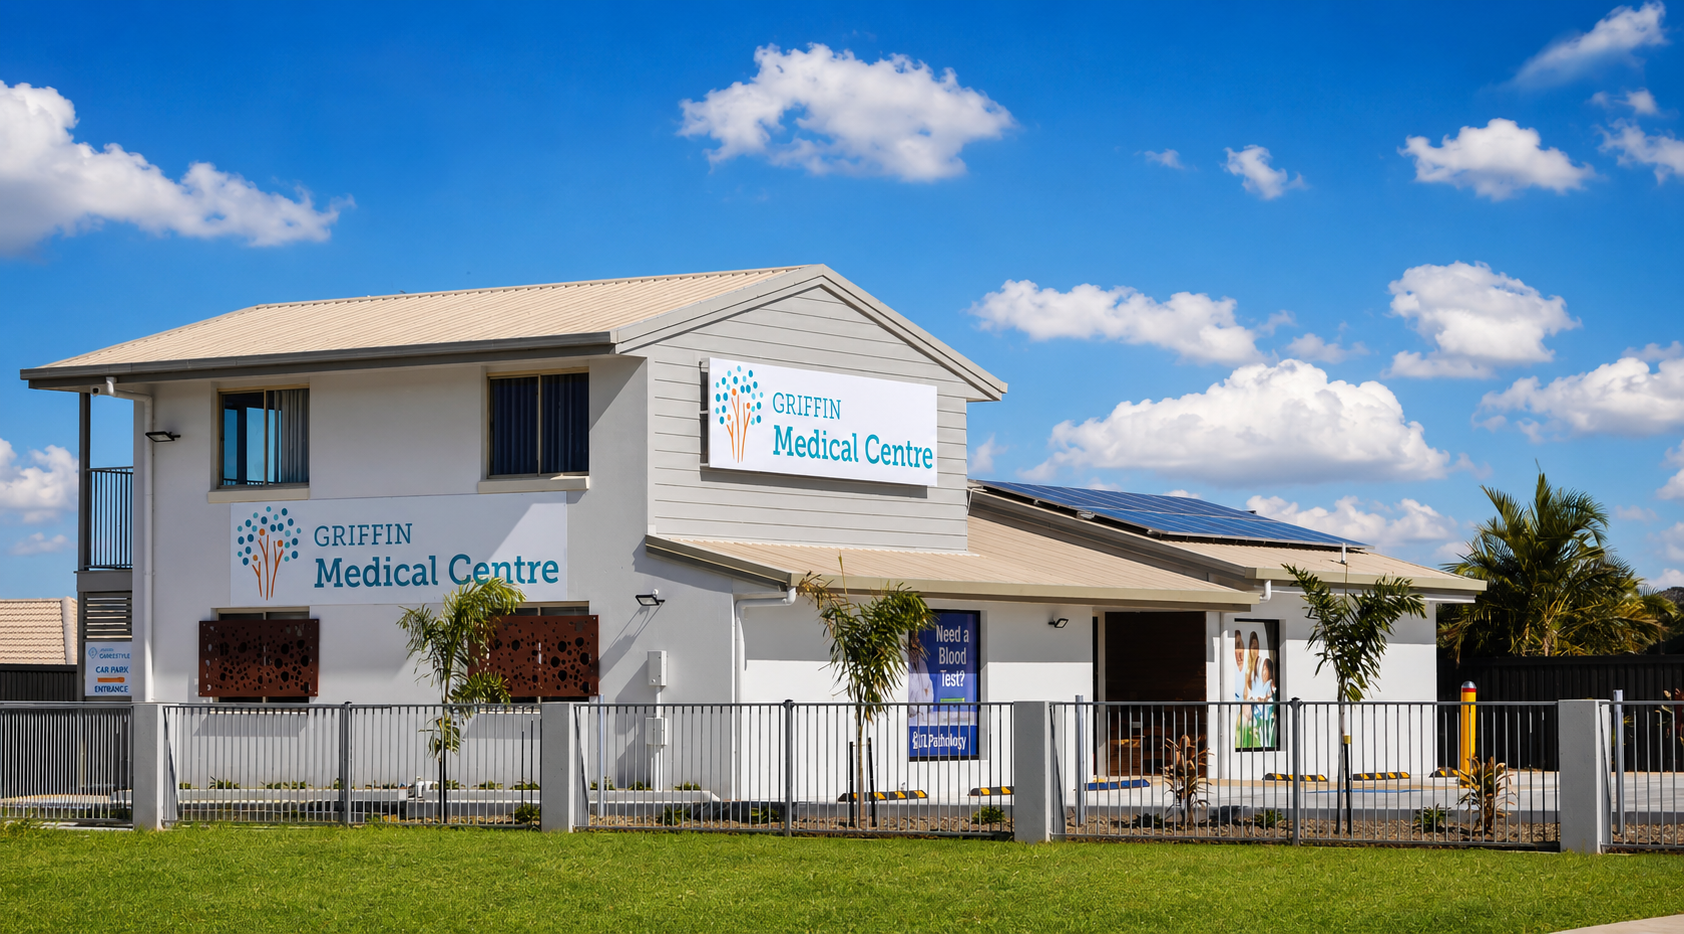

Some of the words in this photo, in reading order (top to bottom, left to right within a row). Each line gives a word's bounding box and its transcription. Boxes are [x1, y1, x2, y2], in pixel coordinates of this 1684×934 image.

[773, 392, 841, 420] GRIFFIN
[773, 425, 859, 462] Medical
[865, 434, 933, 469] Centre
[314, 523, 412, 547] GRIFFIN
[315, 555, 438, 588] Medical
[448, 553, 558, 585] Centre
[936, 625, 961, 643] Need
[963, 630, 969, 643] a
[939, 646, 967, 665] Blood
[940, 669, 965, 687] Test?
[928, 734, 966, 750] Pathology
